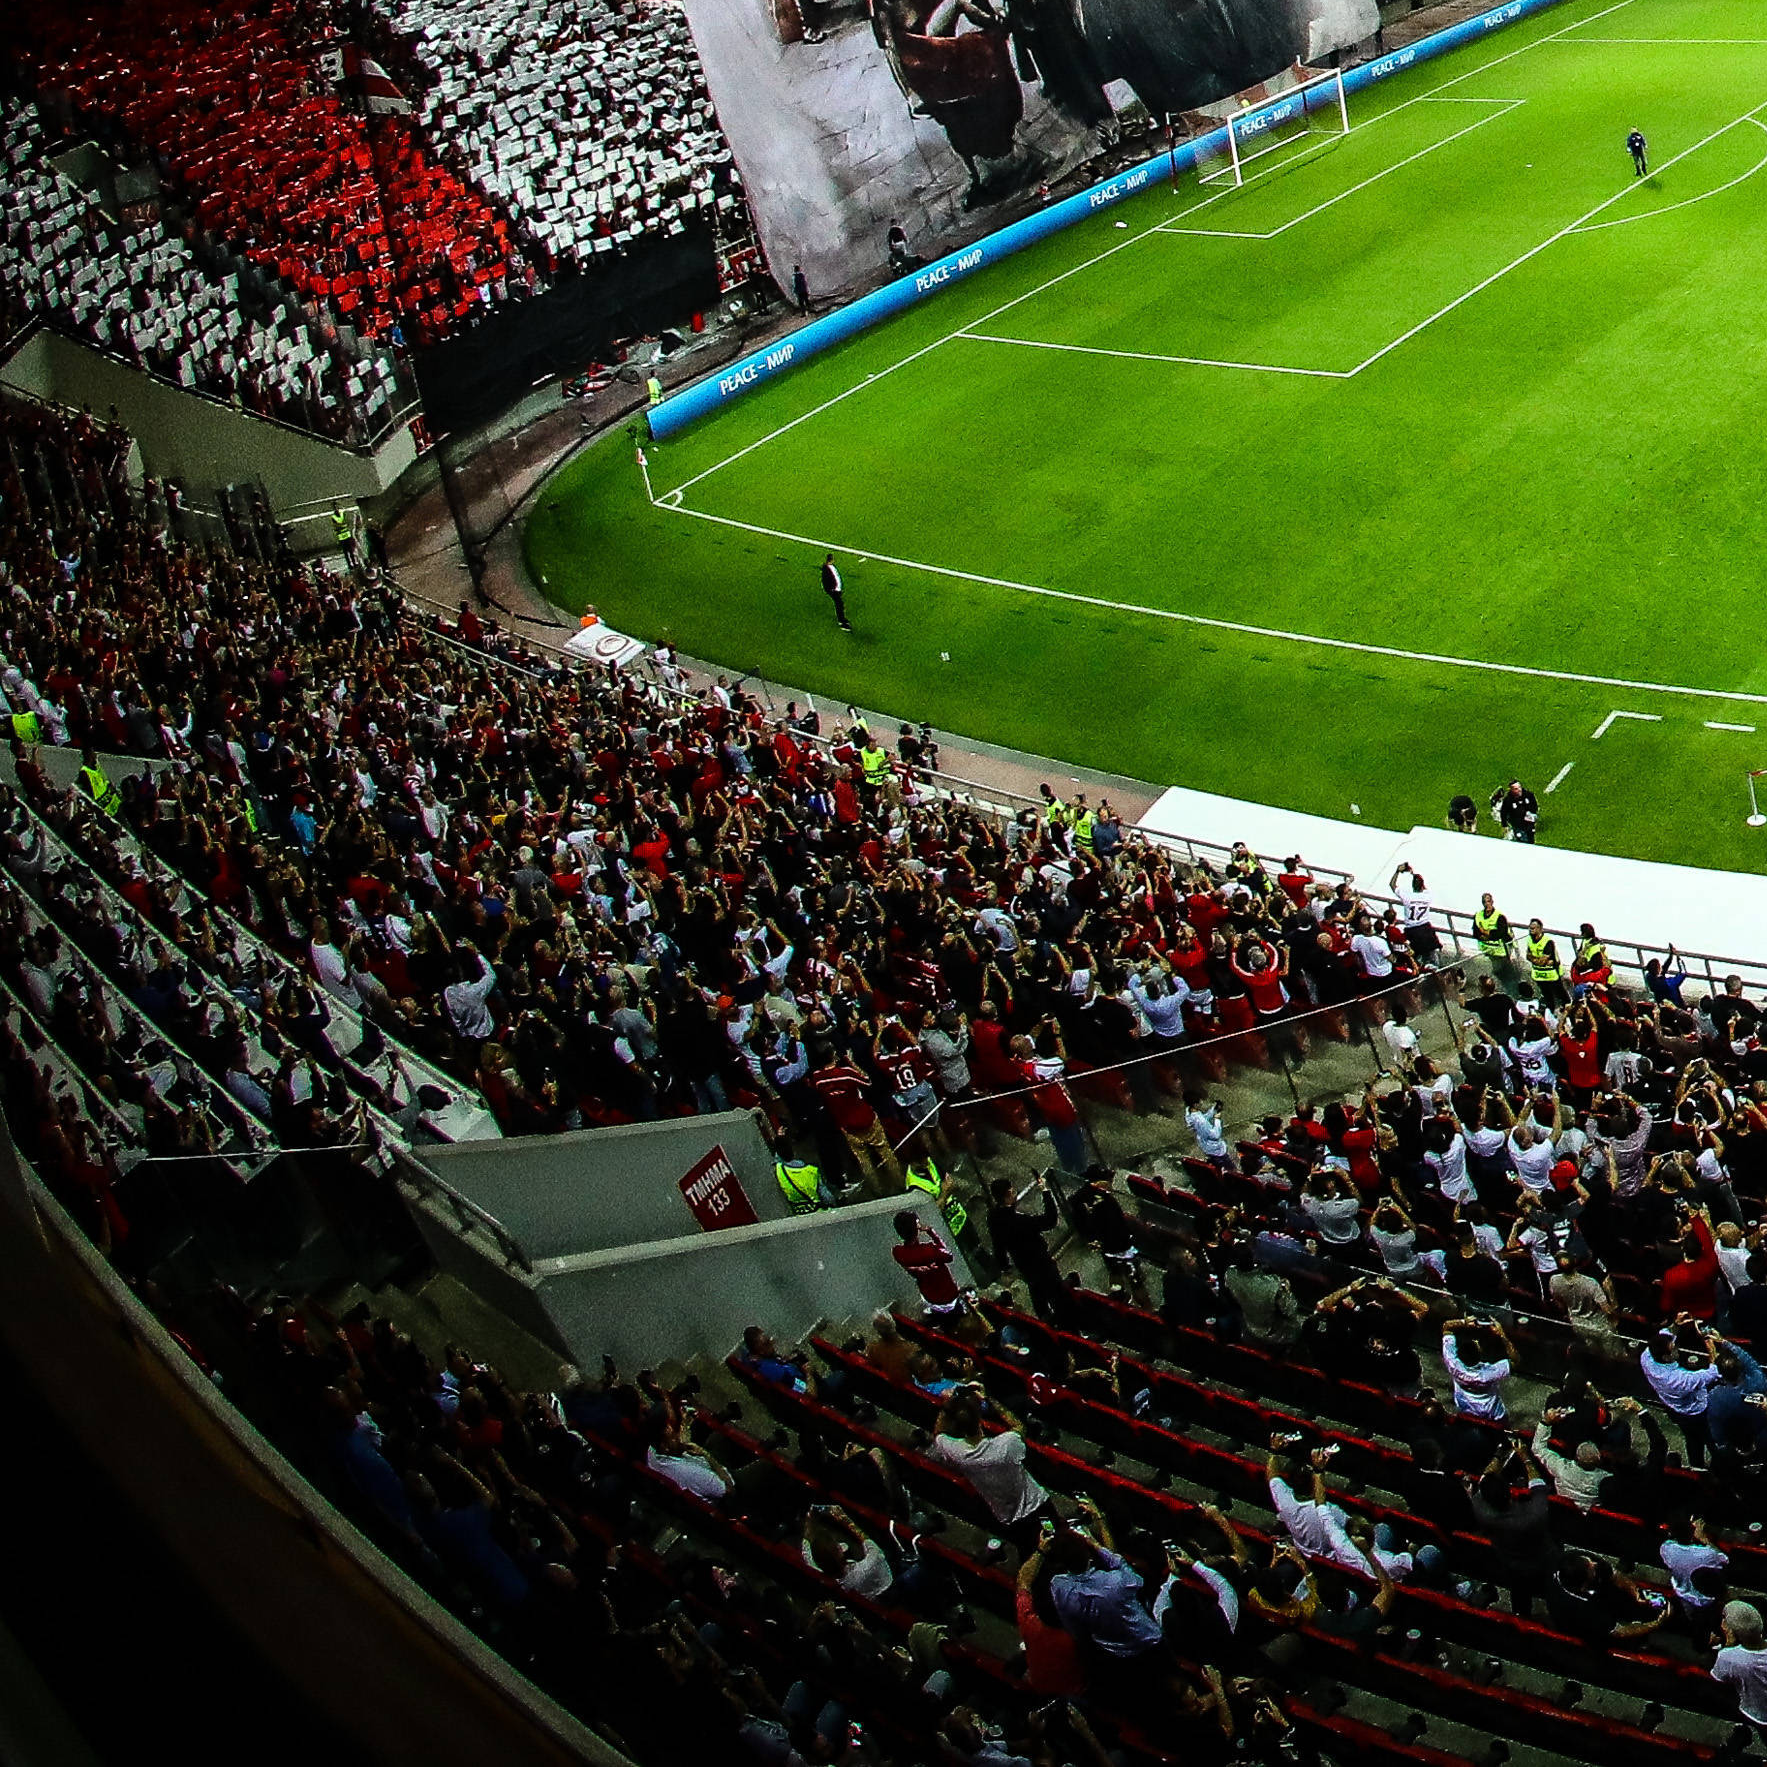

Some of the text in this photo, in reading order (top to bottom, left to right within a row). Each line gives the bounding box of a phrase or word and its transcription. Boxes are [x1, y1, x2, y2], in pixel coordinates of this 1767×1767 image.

[1371, 60, 1395, 77] PEACE
[1241, 116, 1268, 136] PEACE
[1090, 187, 1119, 207] PEACE
[916, 266, 951, 292] PEACE
[720, 365, 758, 395] PEACE
[896, 1068, 917, 1090] 19
[707, 1187, 732, 1217] 133
